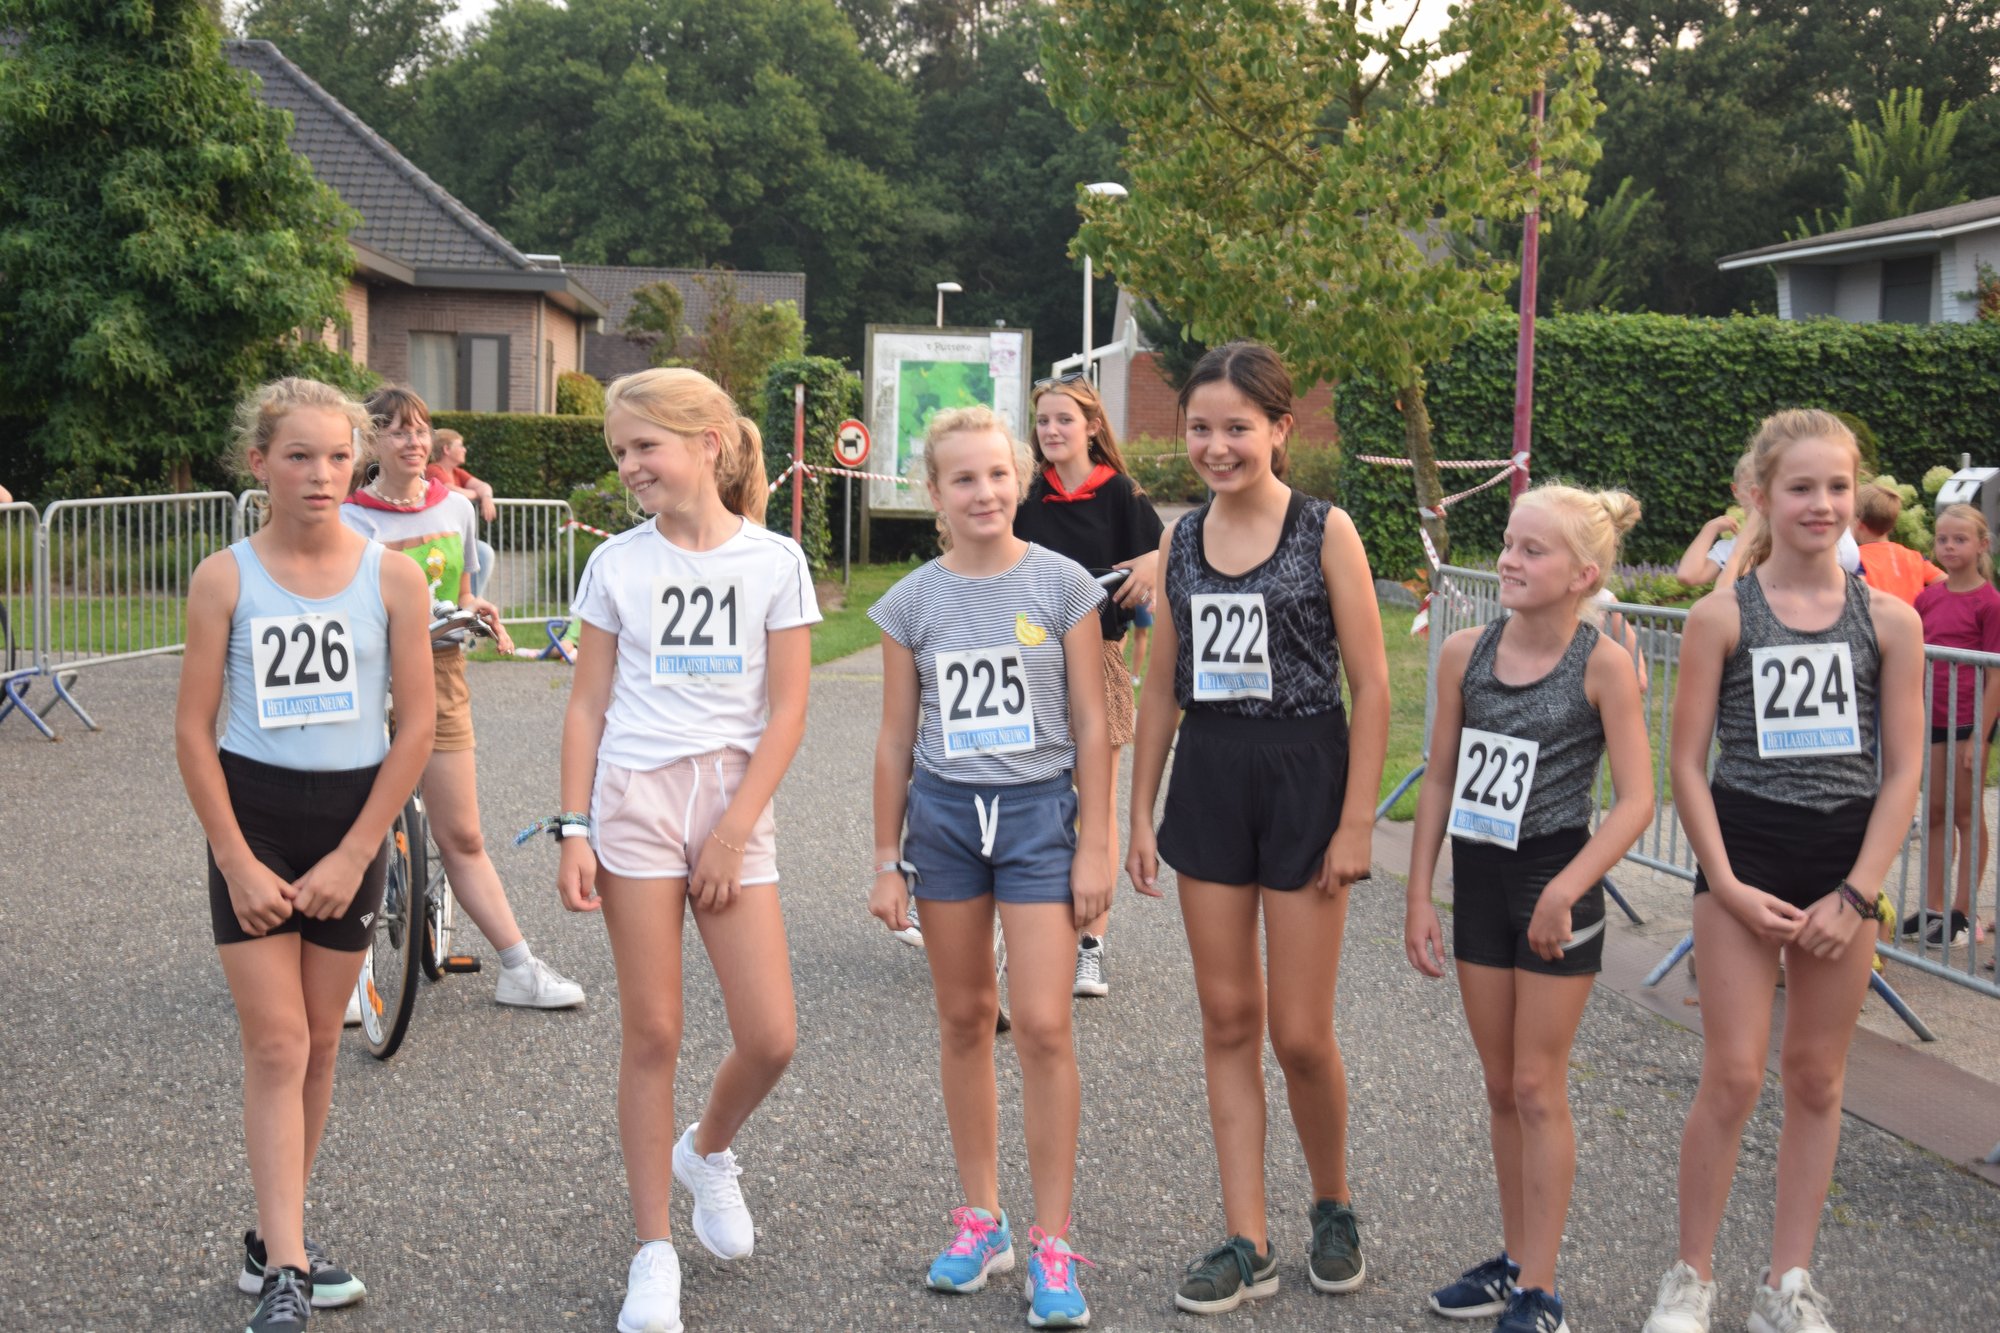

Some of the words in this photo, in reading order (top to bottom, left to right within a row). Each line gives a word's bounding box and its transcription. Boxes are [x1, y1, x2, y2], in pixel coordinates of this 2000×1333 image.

[661, 585, 736, 646] 221
[1200, 603, 1264, 663] 222
[262, 620, 349, 688] 226
[1761, 653, 1848, 719] 224
[946, 656, 1025, 720] 225
[1461, 741, 1529, 811] 223
